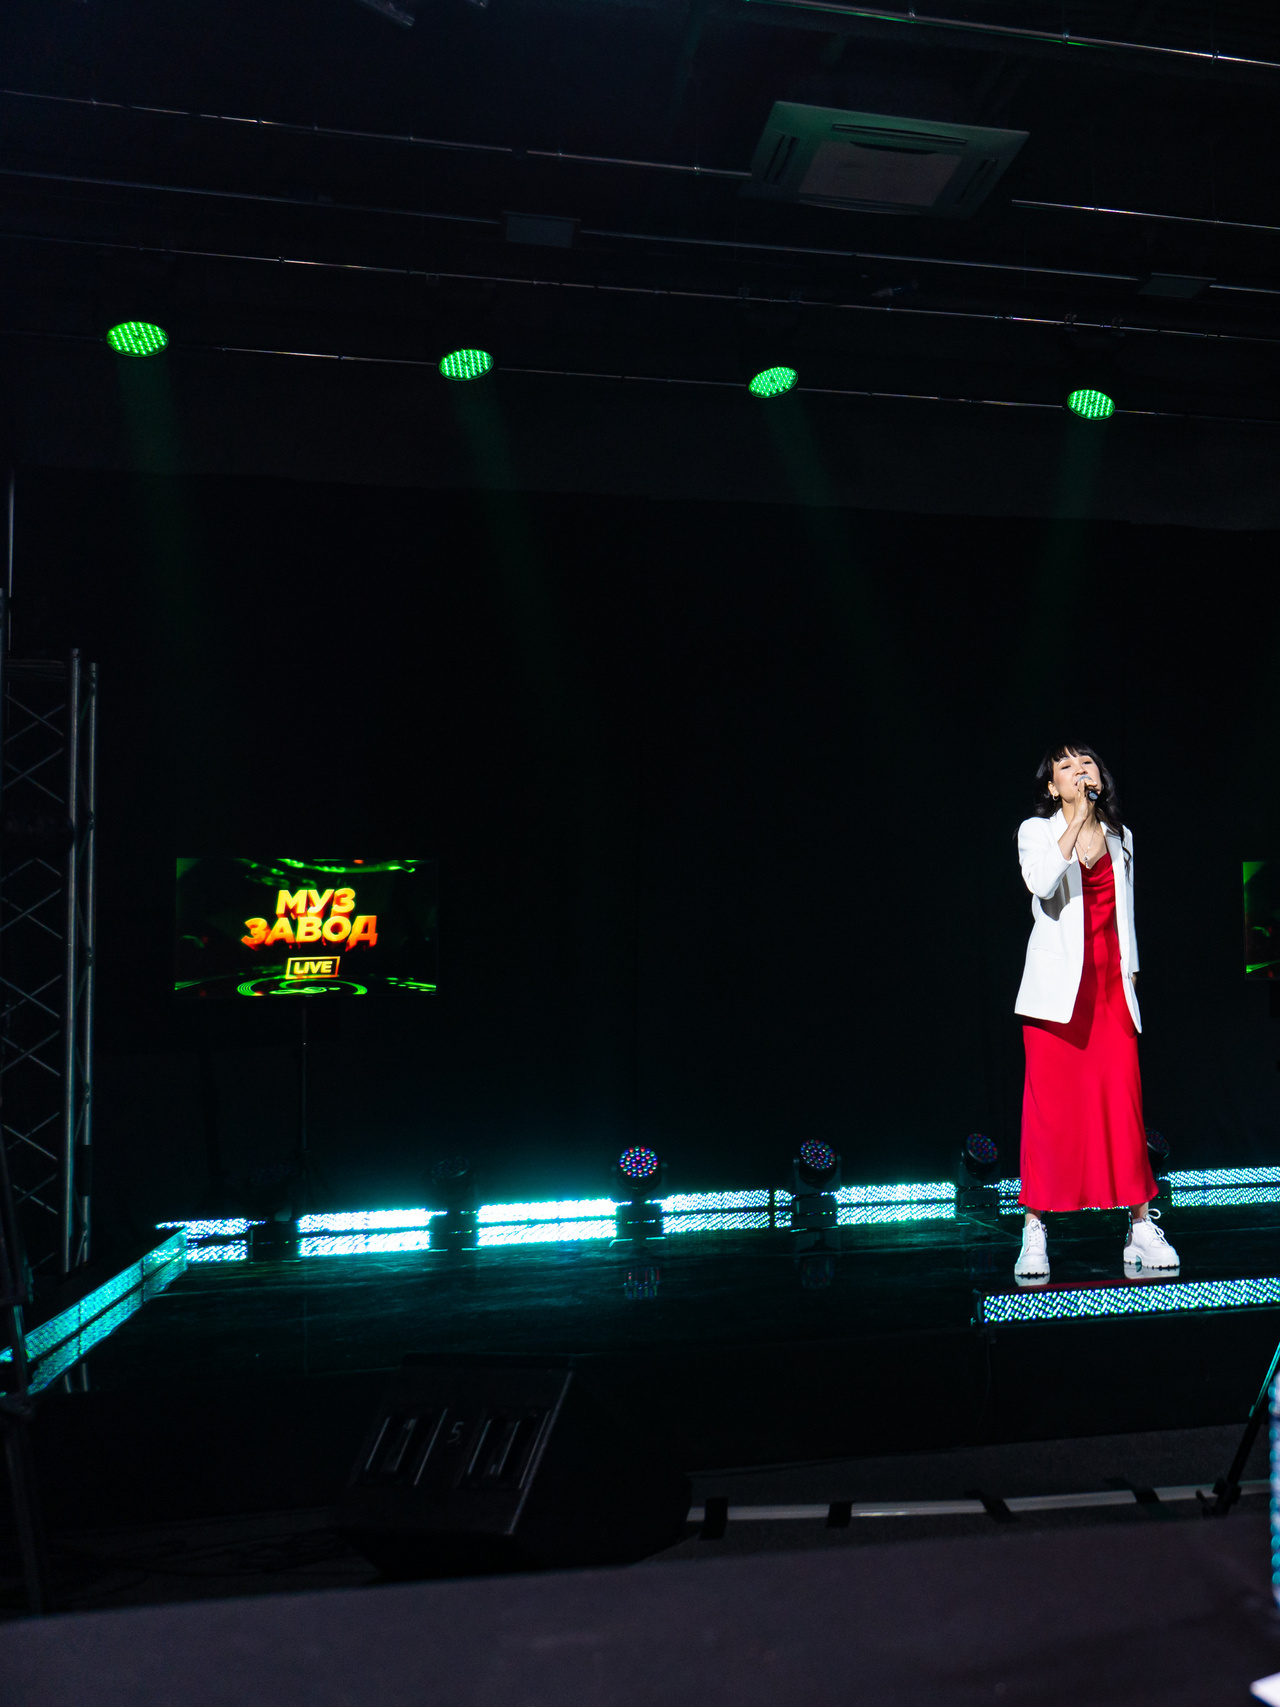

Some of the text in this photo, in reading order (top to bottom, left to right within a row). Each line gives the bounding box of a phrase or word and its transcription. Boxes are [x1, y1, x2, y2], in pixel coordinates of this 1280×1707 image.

[276, 888, 356, 917] МУЗ
[241, 915, 378, 951] ЗАВОД
[294, 961, 332, 974] LIVE
